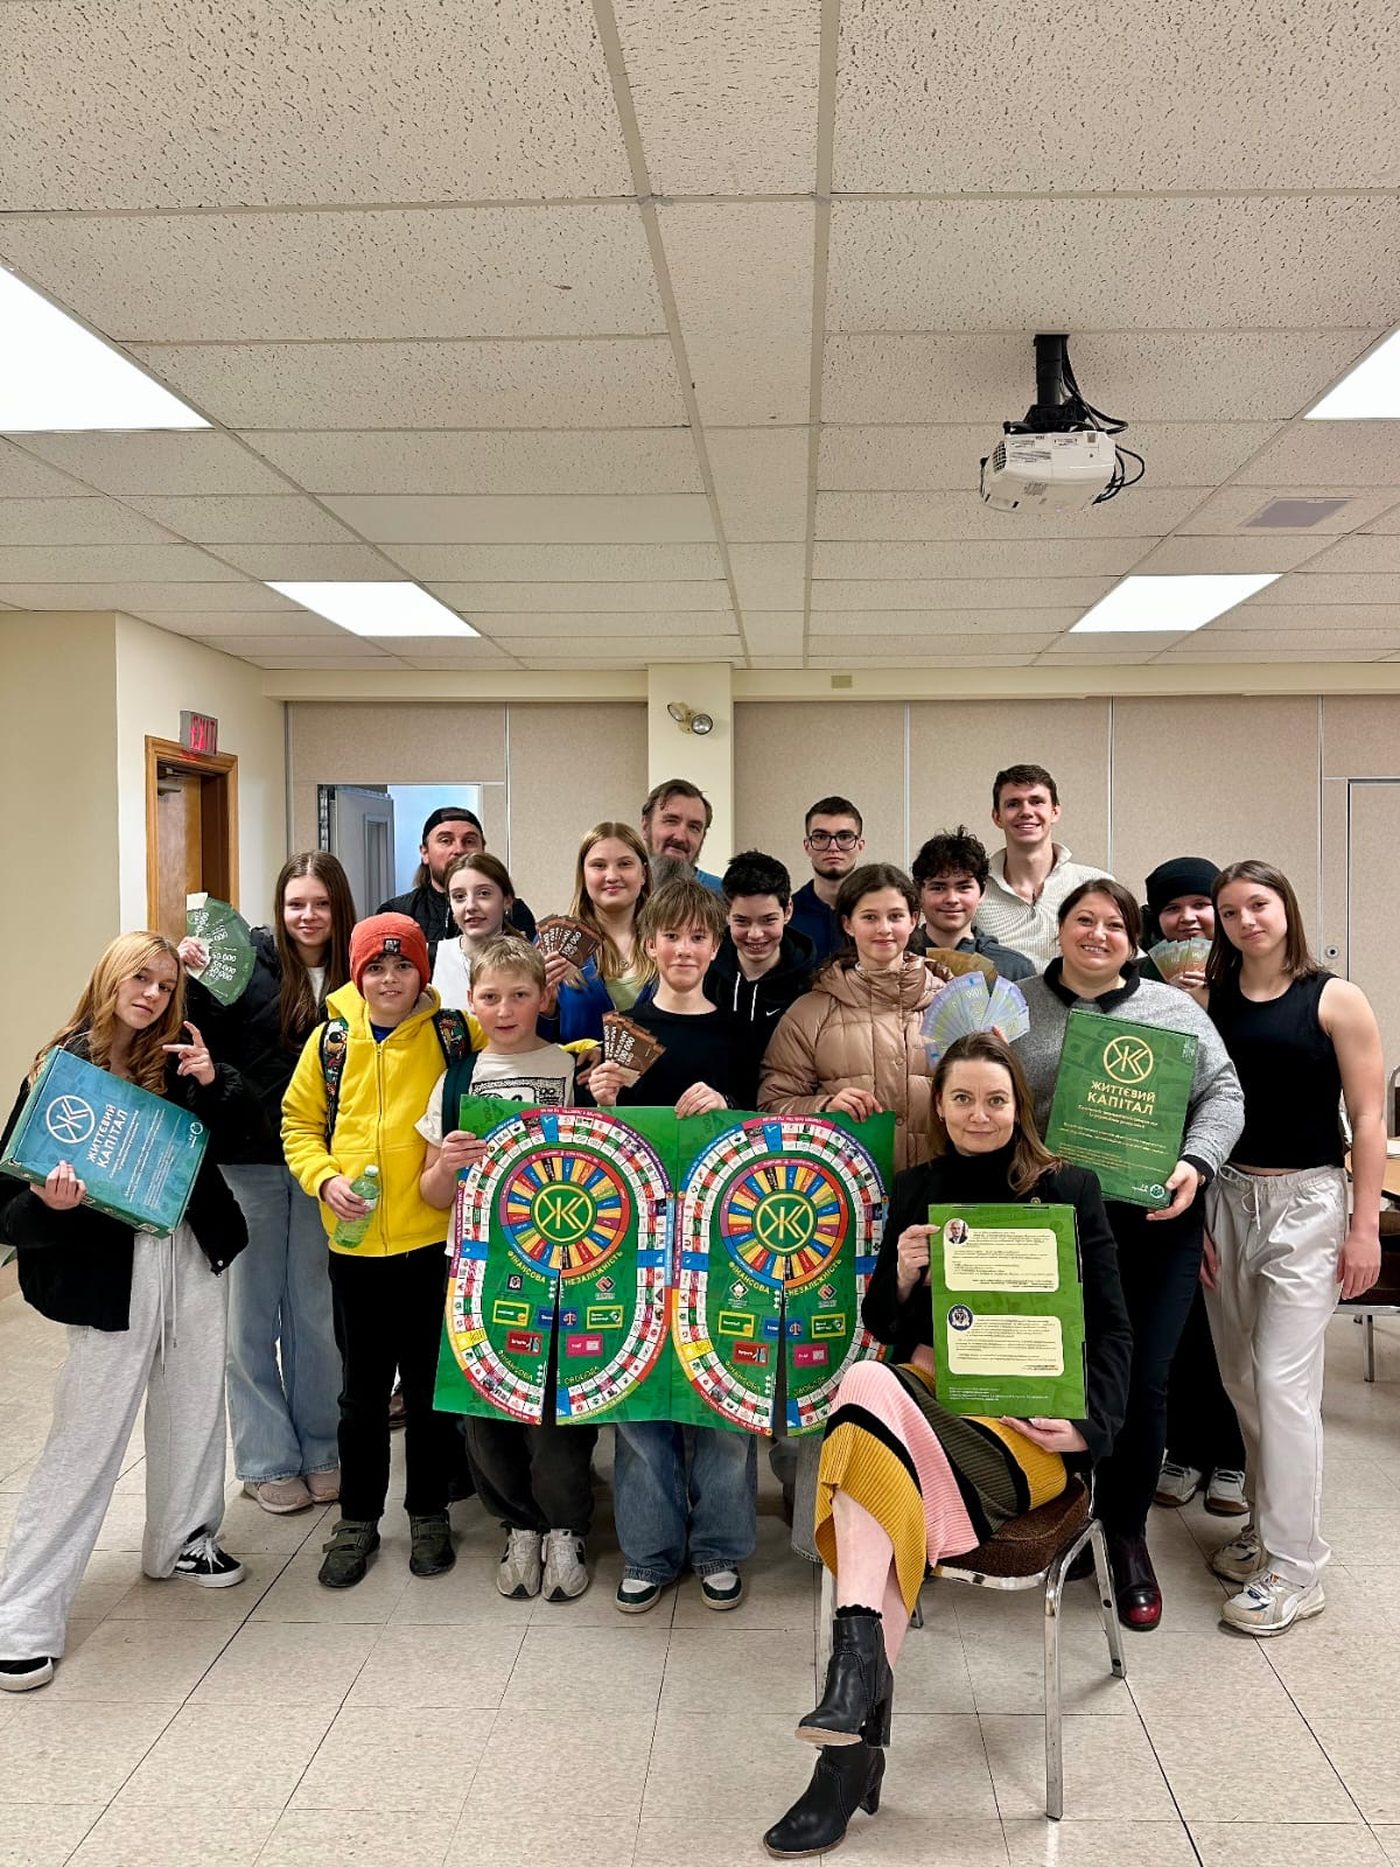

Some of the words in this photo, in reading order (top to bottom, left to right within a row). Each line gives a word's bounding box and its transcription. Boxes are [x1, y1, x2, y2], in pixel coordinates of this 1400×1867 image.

[191, 715, 216, 752] EXIT
[1087, 1092, 1154, 1115] КАПІТАЛ
[1091, 1080, 1156, 1103] ЖИТТЄВИЙ
[86, 1104, 116, 1163] ЖИТТЄВИЙ
[96, 1109, 128, 1168] КАПІТАЛ
[507, 1250, 546, 1283] ФІНАНСОВА
[729, 1261, 770, 1294] ФІНАНСОВА
